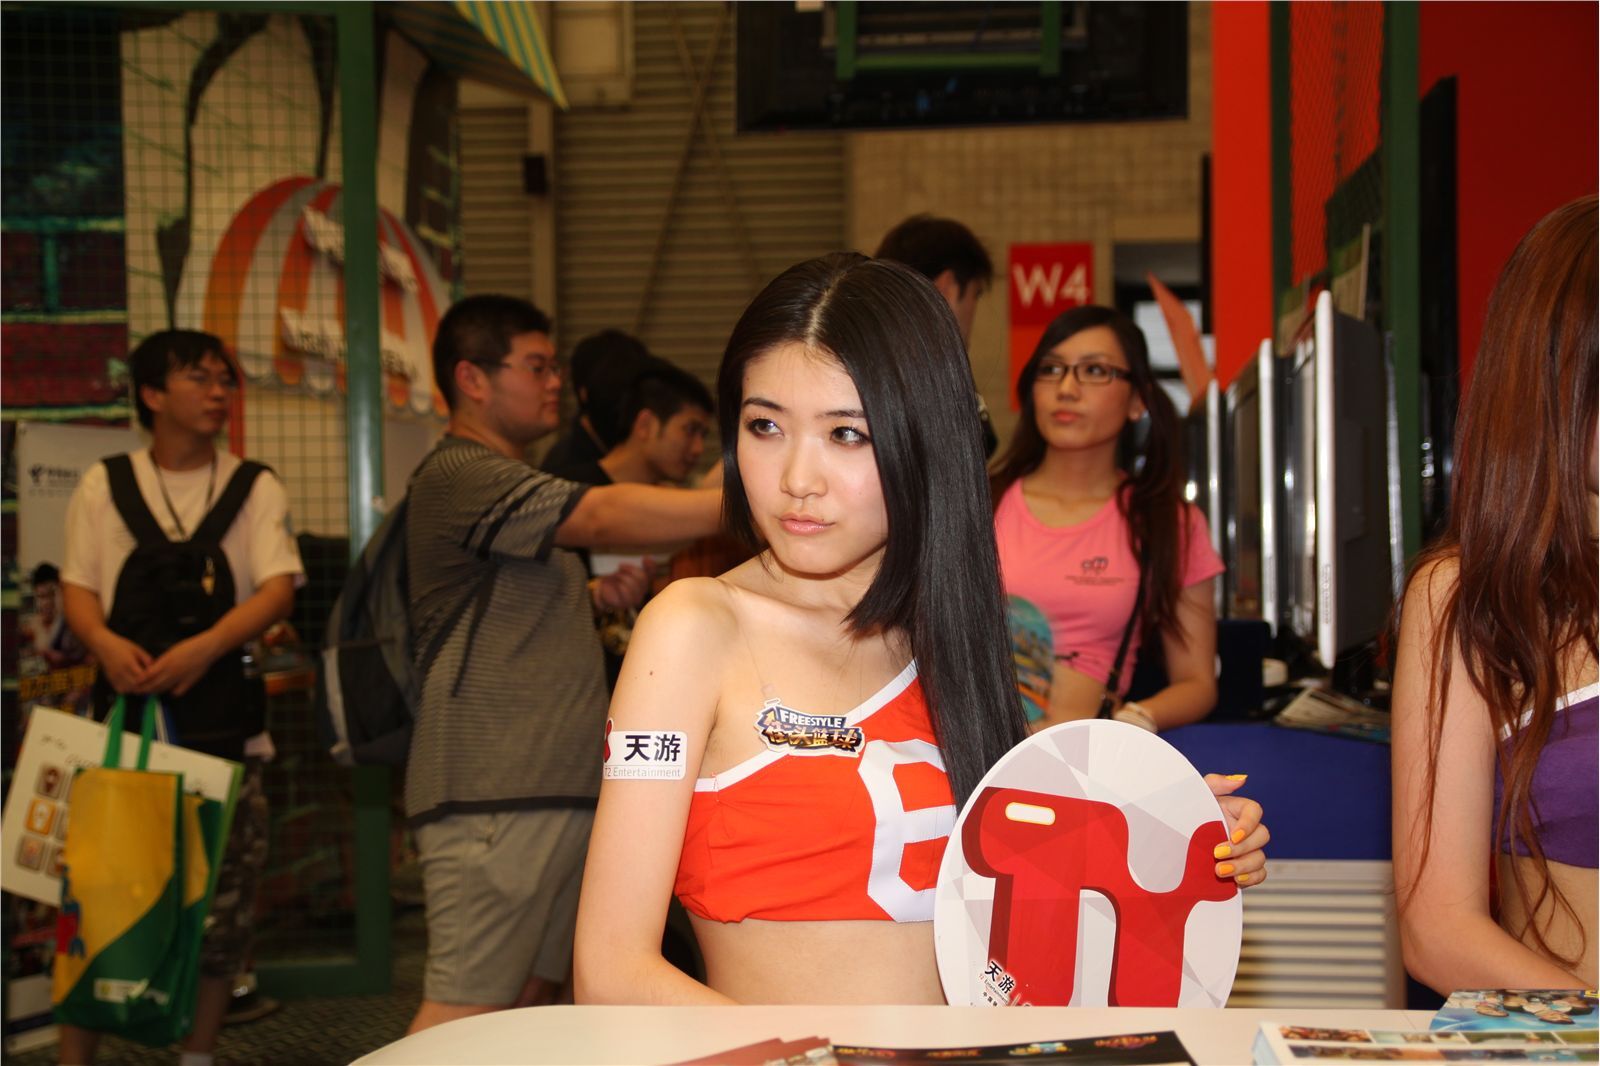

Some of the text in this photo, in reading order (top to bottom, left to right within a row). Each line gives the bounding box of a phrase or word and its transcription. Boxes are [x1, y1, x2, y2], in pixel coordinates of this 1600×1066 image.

[1012, 262, 1091, 308] W4
[779, 709, 842, 728] FREESTYLE
[624, 734, 681, 762] 天游
[613, 767, 680, 777] Entertainment
[985, 961, 1014, 993] 天游
